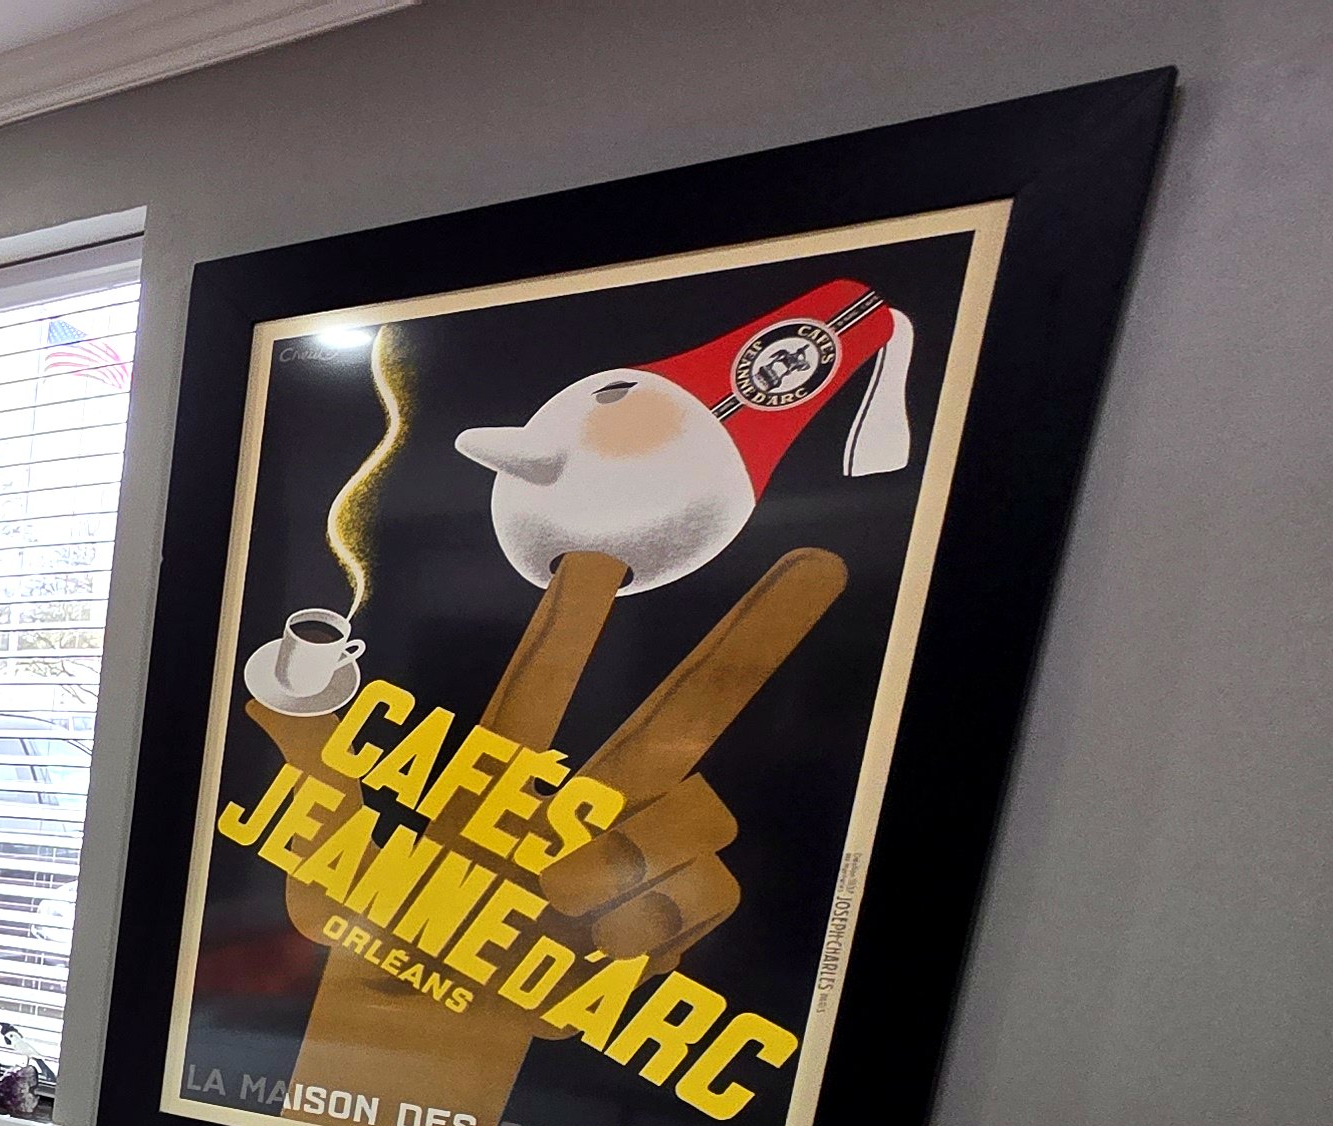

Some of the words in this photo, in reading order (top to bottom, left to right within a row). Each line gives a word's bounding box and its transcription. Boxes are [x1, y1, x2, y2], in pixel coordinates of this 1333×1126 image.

[736, 341, 763, 397] JEANNE
[320, 680, 625, 876] CAFÉS
[218, 763, 549, 985] JEANNE
[498, 934, 799, 1121] D'ARC
[323, 912, 474, 1015] ORLÉANS
[186, 1063, 226, 1097] LA
[239, 1073, 379, 1125] MAISON
